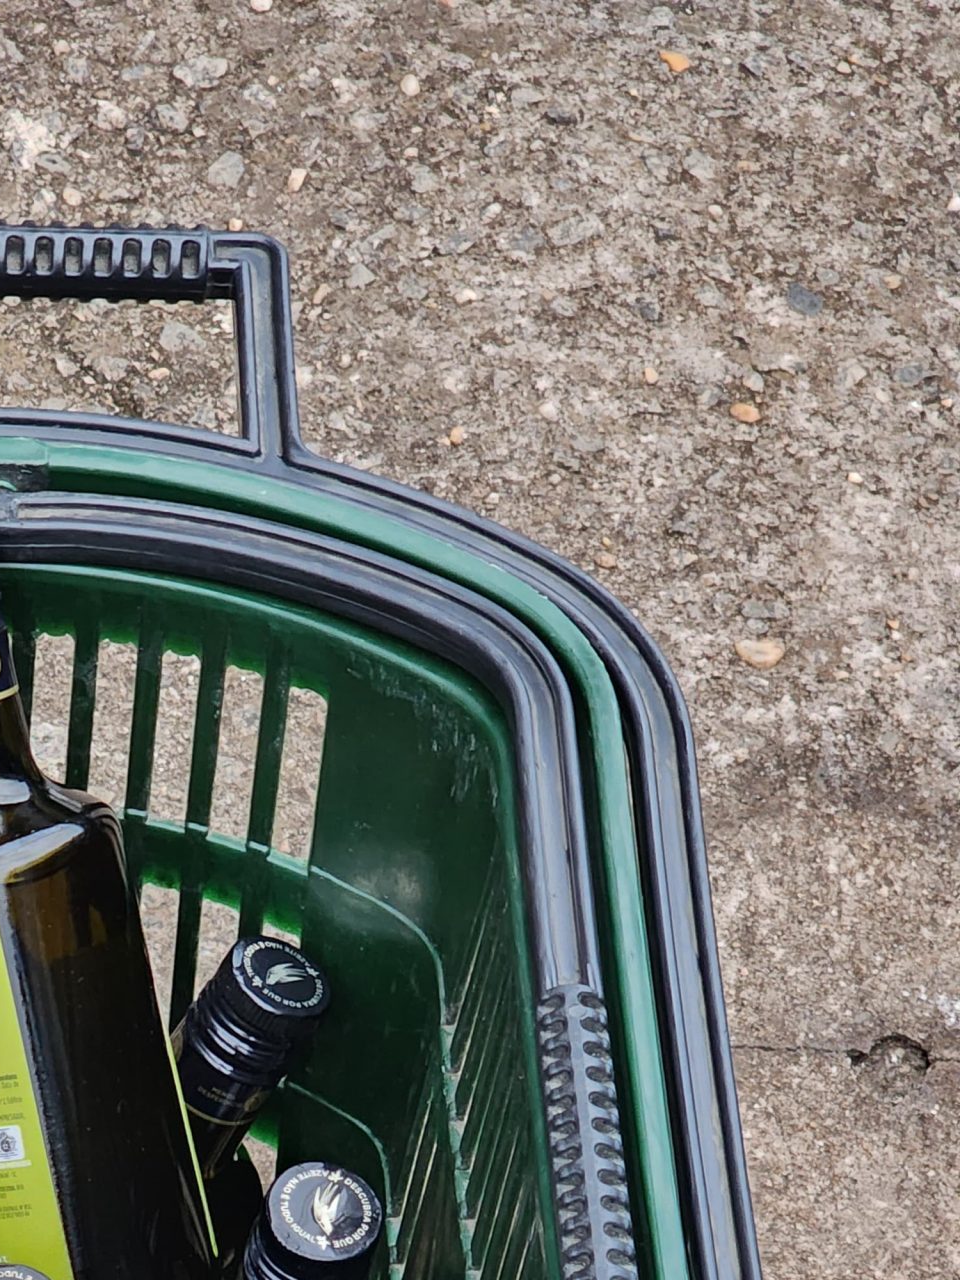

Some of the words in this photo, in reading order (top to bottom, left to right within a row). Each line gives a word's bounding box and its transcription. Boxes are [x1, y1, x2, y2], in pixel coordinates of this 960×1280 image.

[344, 1178, 373, 1223] DESCUBRA
[280, 1202, 294, 1223] TUDO
[291, 1223, 316, 1243] IGUAL
[352, 1223, 369, 1240] POR
[332, 1237, 354, 1248] QUE
